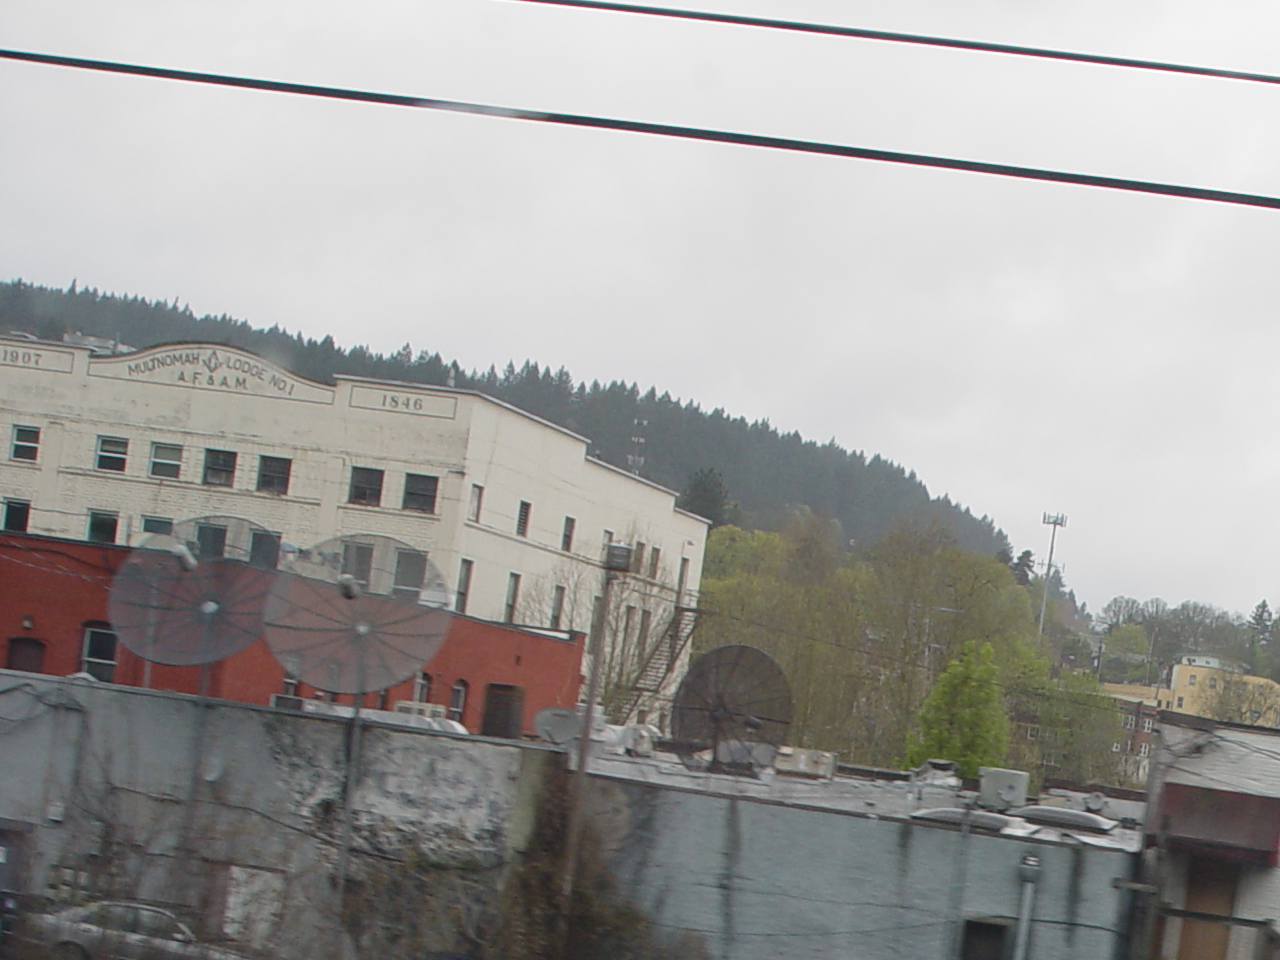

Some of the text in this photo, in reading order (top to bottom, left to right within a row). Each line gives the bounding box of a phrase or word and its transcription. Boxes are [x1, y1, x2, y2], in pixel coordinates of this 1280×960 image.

[2, 349, 43, 366] 1907
[126, 352, 200, 377] MULTNOMAH
[226, 356, 269, 382] LODGE
[381, 394, 423, 411] 1846
